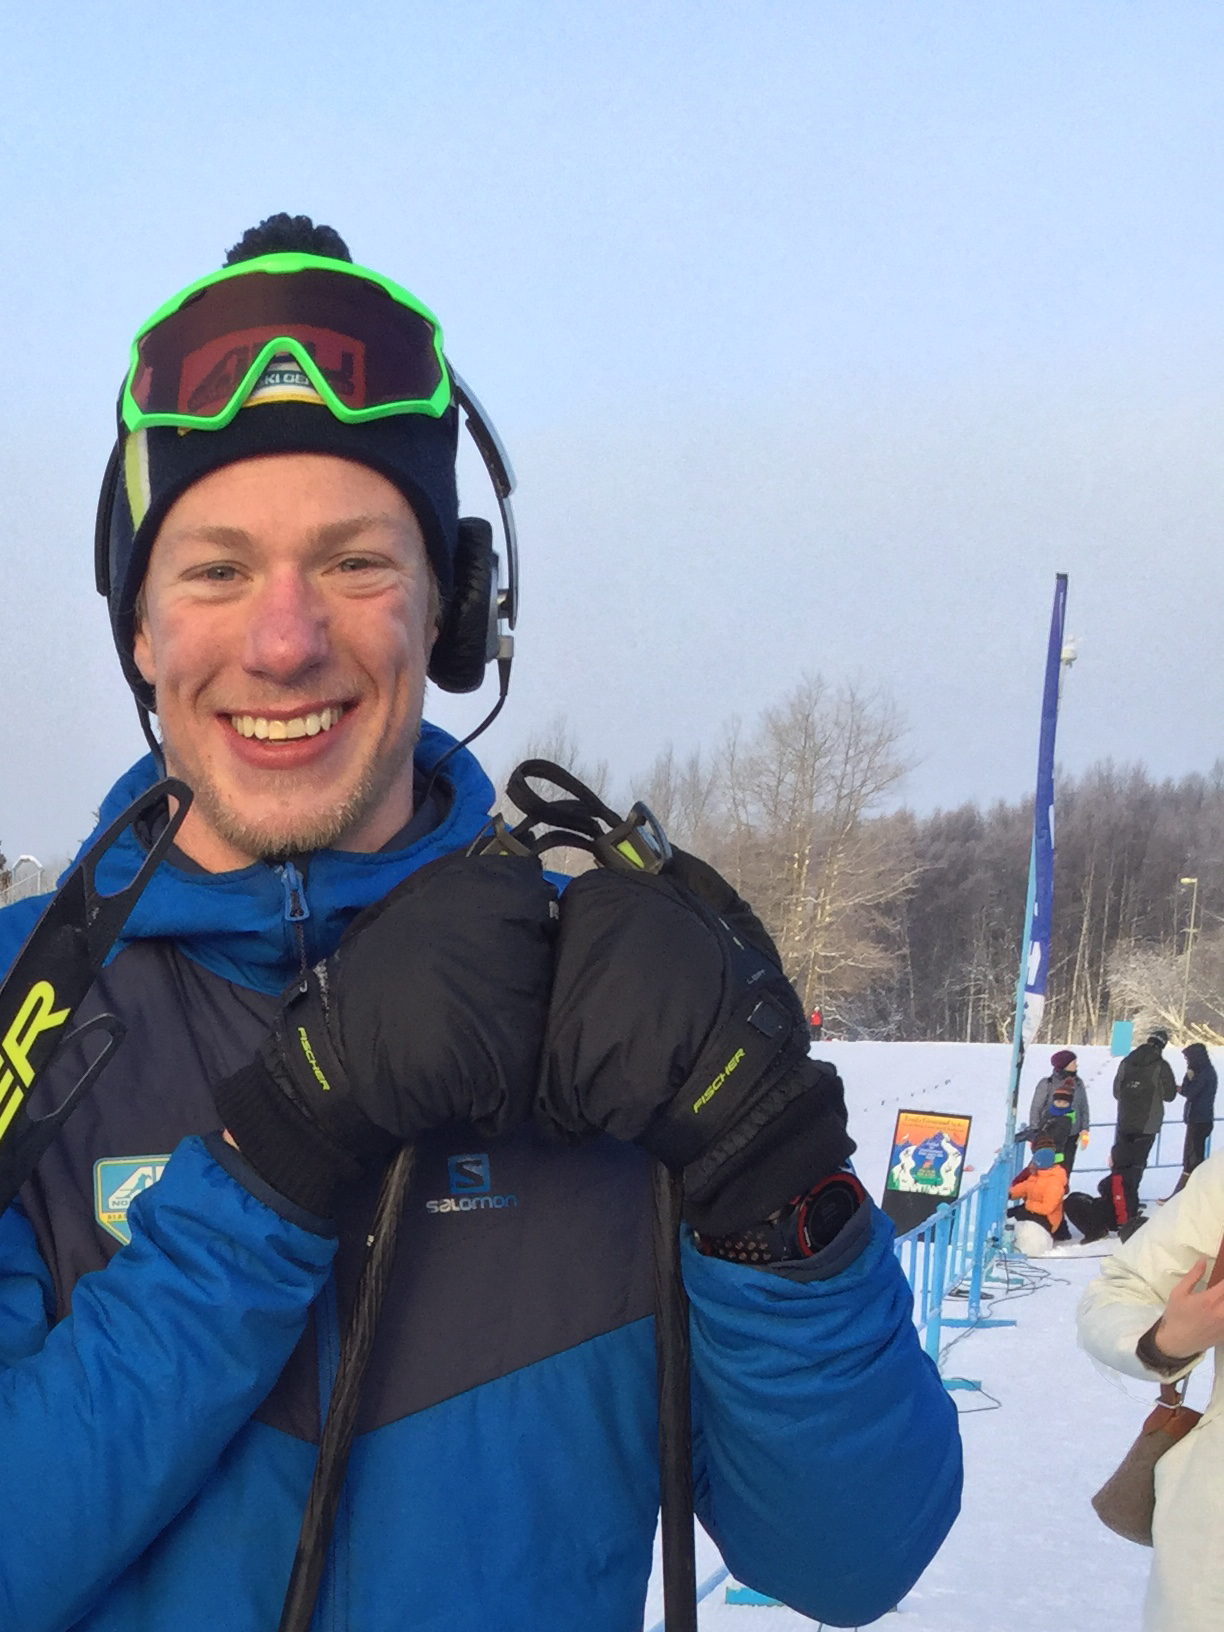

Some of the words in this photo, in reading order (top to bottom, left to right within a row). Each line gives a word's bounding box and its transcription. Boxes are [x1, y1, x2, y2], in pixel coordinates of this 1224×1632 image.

[297, 1026, 331, 1091] FISCHER
[692, 1047, 746, 1114] FISCHER
[425, 1193, 519, 1214] salomon
